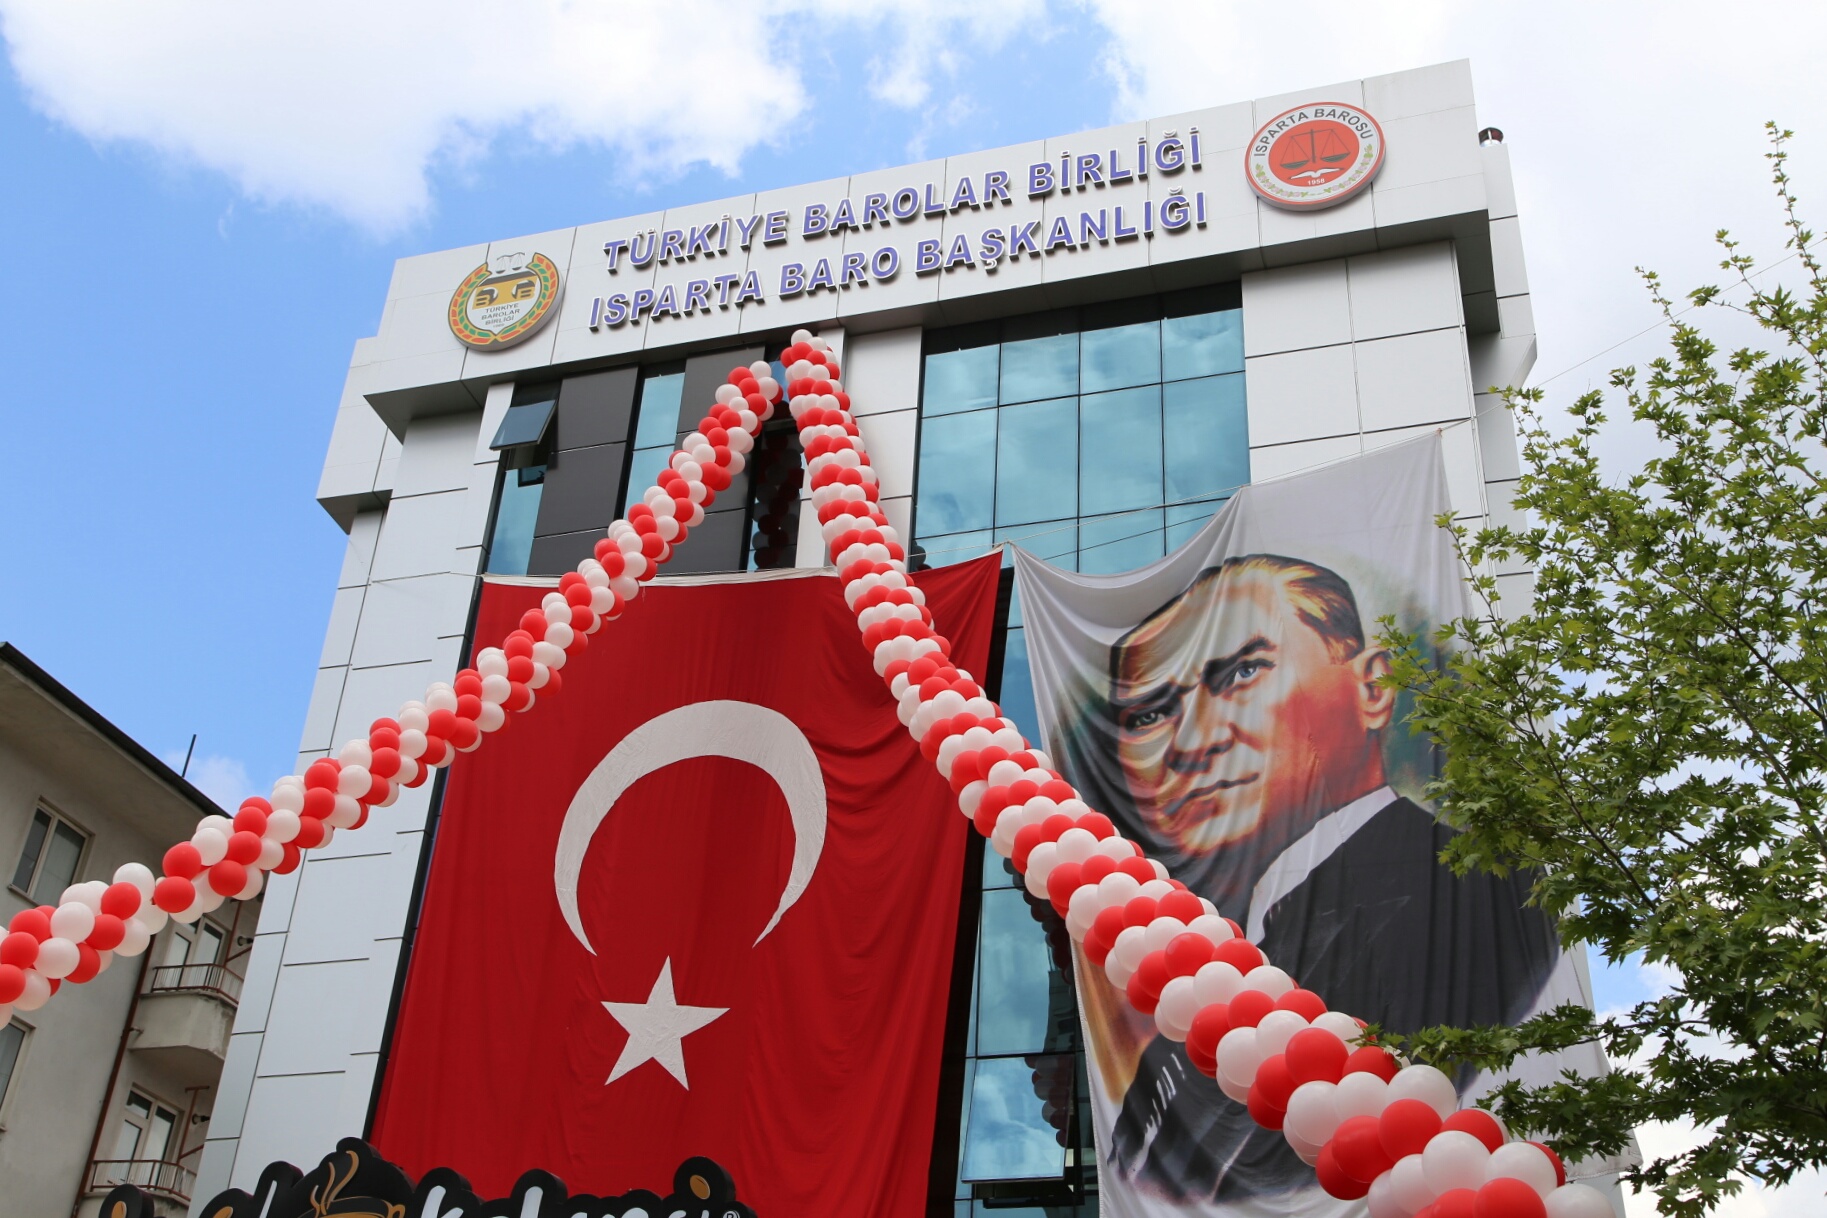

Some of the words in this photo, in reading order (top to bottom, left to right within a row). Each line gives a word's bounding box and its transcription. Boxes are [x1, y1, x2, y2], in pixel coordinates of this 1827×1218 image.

[1254, 111, 1309, 157] ISPARTA
[1314, 108, 1373, 139] BAROSU
[603, 210, 788, 273] TÜRKİYE
[802, 170, 1011, 237] BAROLAR
[1028, 126, 1202, 198] BİRLİĞİ
[1307, 178, 1325, 186] 1958
[589, 269, 764, 330] ISPARTA
[779, 246, 900, 299] BARO
[915, 186, 1206, 275] BAŞKANLIĞI
[481, 309, 520, 320] BAROLAR
